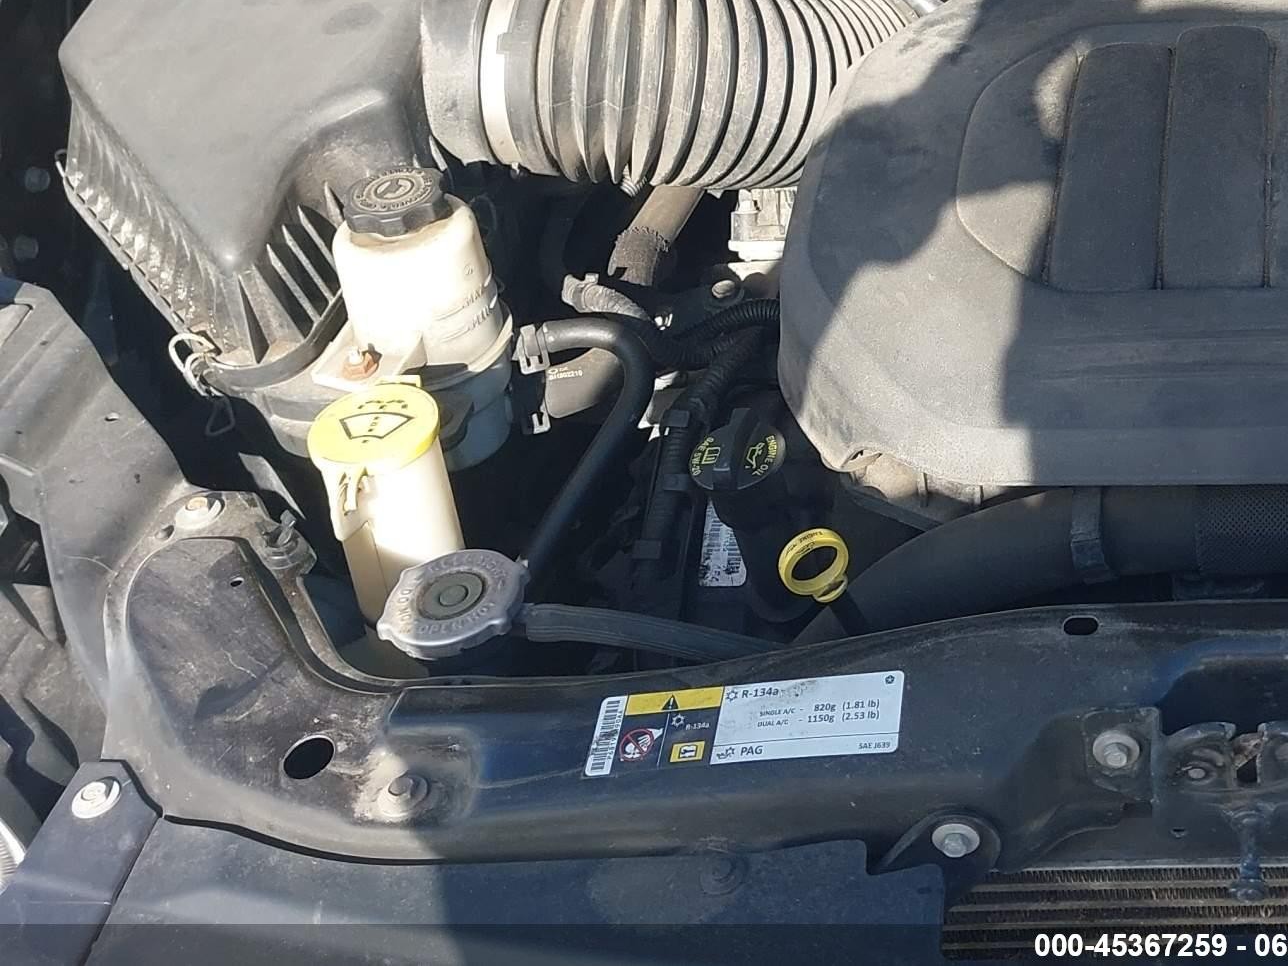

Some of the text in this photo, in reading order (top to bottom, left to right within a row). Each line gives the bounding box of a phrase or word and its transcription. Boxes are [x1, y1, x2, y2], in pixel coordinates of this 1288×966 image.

[691, 436, 715, 476] SAE 5W-20
[751, 435, 778, 476] ENGINE OIL
[415, 619, 464, 635] OPEN
[740, 686, 780, 699] R-134a
[759, 709, 782, 718] SINGLE
[782, 707, 796, 716] A/C
[813, 702, 837, 713] 820g
[842, 700, 865, 710] (1.81
[867, 698, 880, 709] lb)
[757, 720, 775, 728] DUAL
[775, 718, 789, 727] A/C
[807, 714, 836, 724] 1150g
[841, 711, 865, 722] (2.53
[867, 710, 880, 721] lb)
[740, 745, 764, 756] PAG
[858, 741, 891, 750] SAE J639
